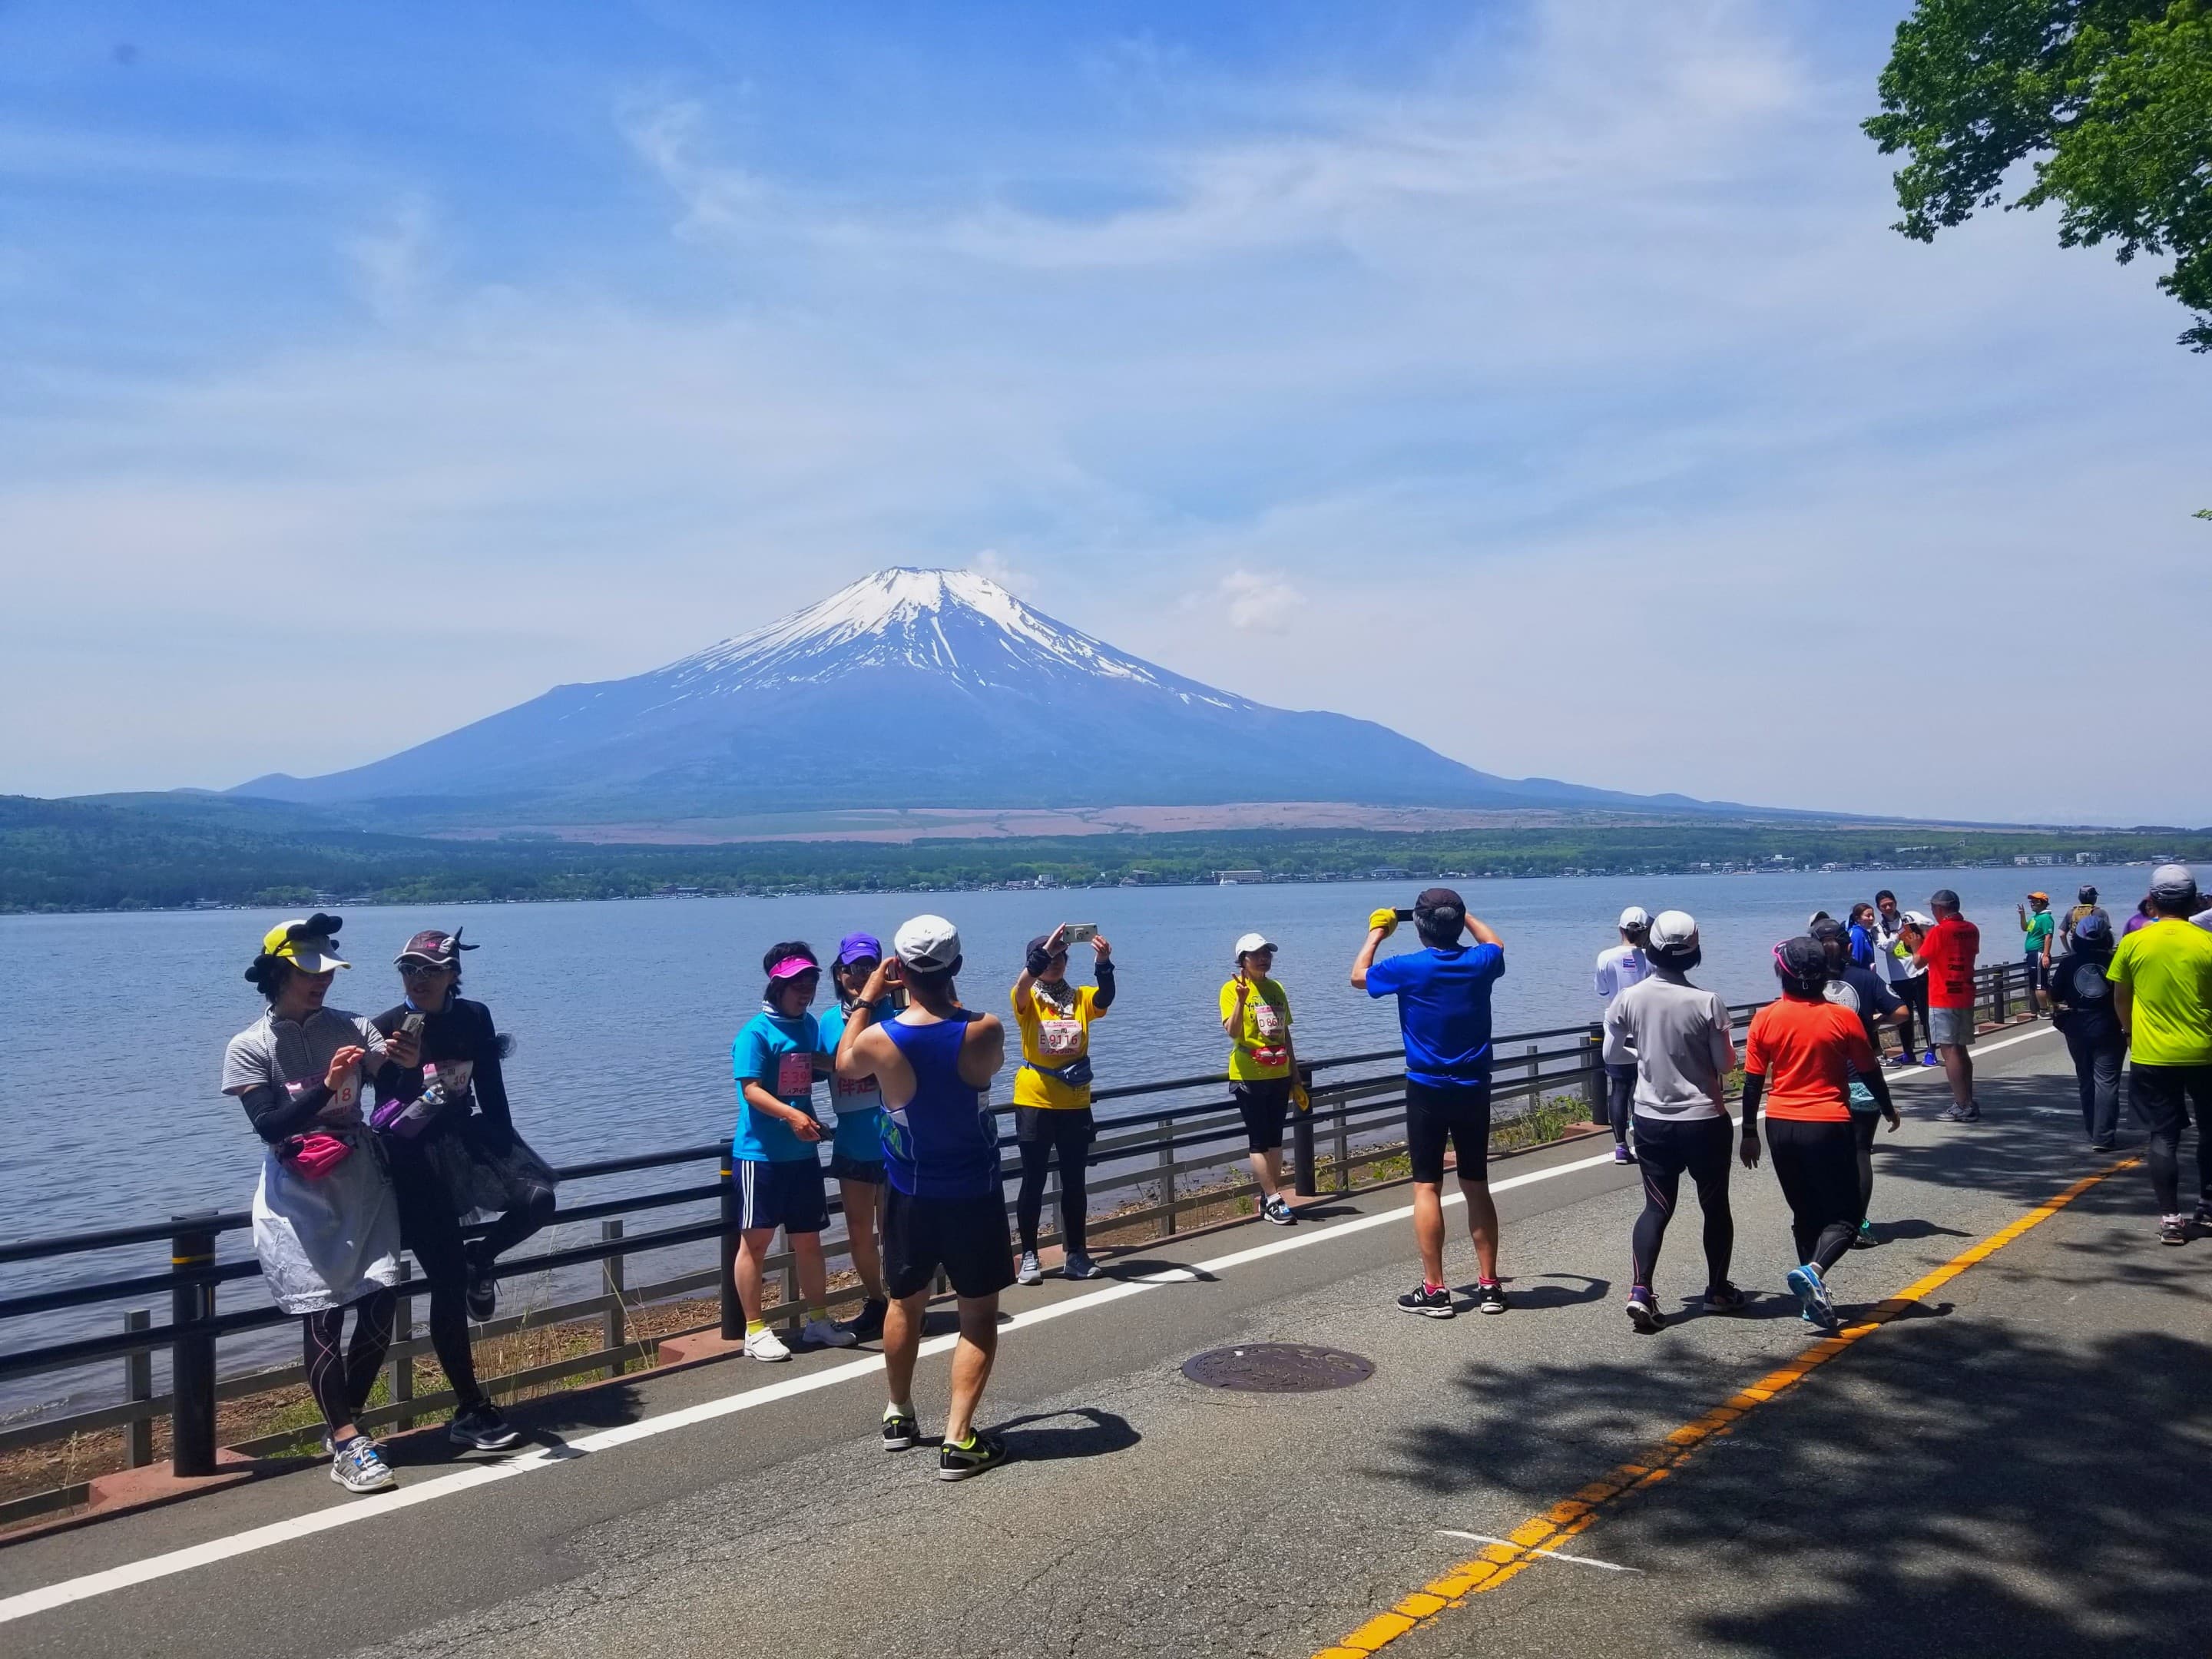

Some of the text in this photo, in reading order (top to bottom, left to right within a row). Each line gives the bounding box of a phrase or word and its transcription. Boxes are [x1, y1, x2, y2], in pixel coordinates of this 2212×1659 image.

[1040, 1035, 1078, 1045] E 9116
[1414, 1291, 1424, 1303] N
